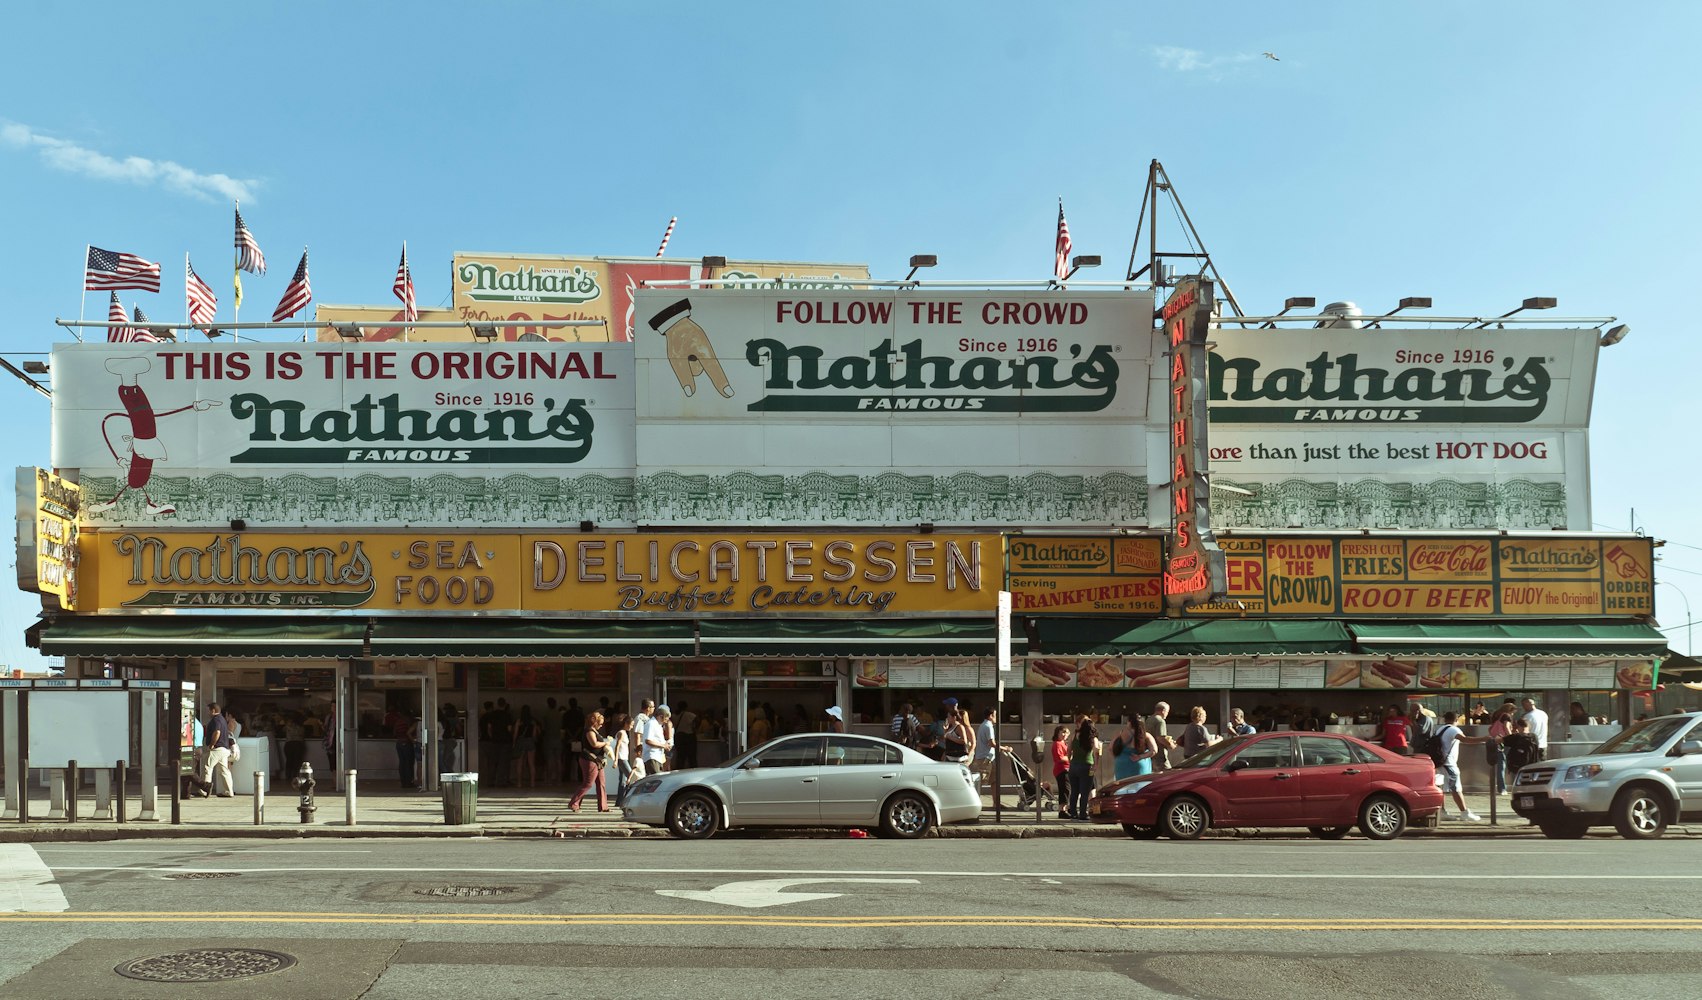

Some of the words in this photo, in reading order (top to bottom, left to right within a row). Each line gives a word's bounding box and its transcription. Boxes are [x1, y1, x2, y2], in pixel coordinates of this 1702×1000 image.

[459, 262, 598, 294] Nathan's
[776, 301, 893, 325] FOLLOW
[907, 301, 963, 324] THE
[981, 301, 1089, 325] CROWD
[1162, 288, 1195, 321] ORIGINAL
[958, 338, 1008, 353] Since
[1016, 338, 1059, 353] 1916
[156, 351, 251, 380] THIS
[265, 351, 303, 380] IS
[315, 351, 398, 380] THE
[410, 350, 617, 380] ORIGINAL
[746, 337, 1120, 390] Nathan's
[1395, 350, 1445, 365] Since
[1452, 349, 1495, 364] 1916
[434, 392, 483, 407] Since
[492, 392, 535, 406] 1916
[857, 397, 986, 410] FAMOUS
[230, 392, 595, 443] Nathan's
[1294, 408, 1423, 421] FAMOUS
[347, 449, 472, 462] FAMOUS
[1209, 446, 1243, 460] ore
[1249, 443, 1298, 460] than
[1302, 442, 1342, 463] just
[1348, 443, 1380, 460] the
[1387, 443, 1430, 460] best
[1435, 442, 1489, 460] HOT
[1493, 441, 1548, 460] DOG
[1011, 542, 1108, 563] Nathan's
[1130, 541, 1144, 549] OLD
[1218, 541, 1262, 550] COLD
[1267, 544, 1332, 560] FOLLOW
[1342, 544, 1379, 555] FRESH
[1380, 544, 1402, 555] CUT
[112, 533, 373, 586] Nathan's
[407, 540, 484, 570] SEA
[1117, 554, 1159, 569] LEMONADE
[1409, 544, 1489, 572] Coca-Cola
[1501, 545, 1599, 567] Nathan's
[533, 540, 983, 592] DELICATESSEN
[1285, 561, 1315, 576] THE
[1341, 557, 1403, 576] FRIES
[394, 575, 496, 605] FOOD
[1012, 578, 1057, 589] Serving
[1269, 574, 1333, 607] CROWD
[1606, 580, 1650, 593] ORDER
[173, 592, 282, 606] FAMOUS
[617, 585, 736, 612] Buffet
[749, 585, 898, 613] Catering
[1011, 578, 1161, 609] FRANKFURTERS
[1343, 588, 1420, 608] ROOT
[1425, 588, 1491, 608] BEER
[1503, 587, 1544, 605] ENJOY
[1545, 591, 1559, 605] the
[1561, 591, 1599, 608] Original!
[1607, 596, 1651, 609] HERE!
[1094, 601, 1125, 610] Since
[825, 663, 832, 672] A
